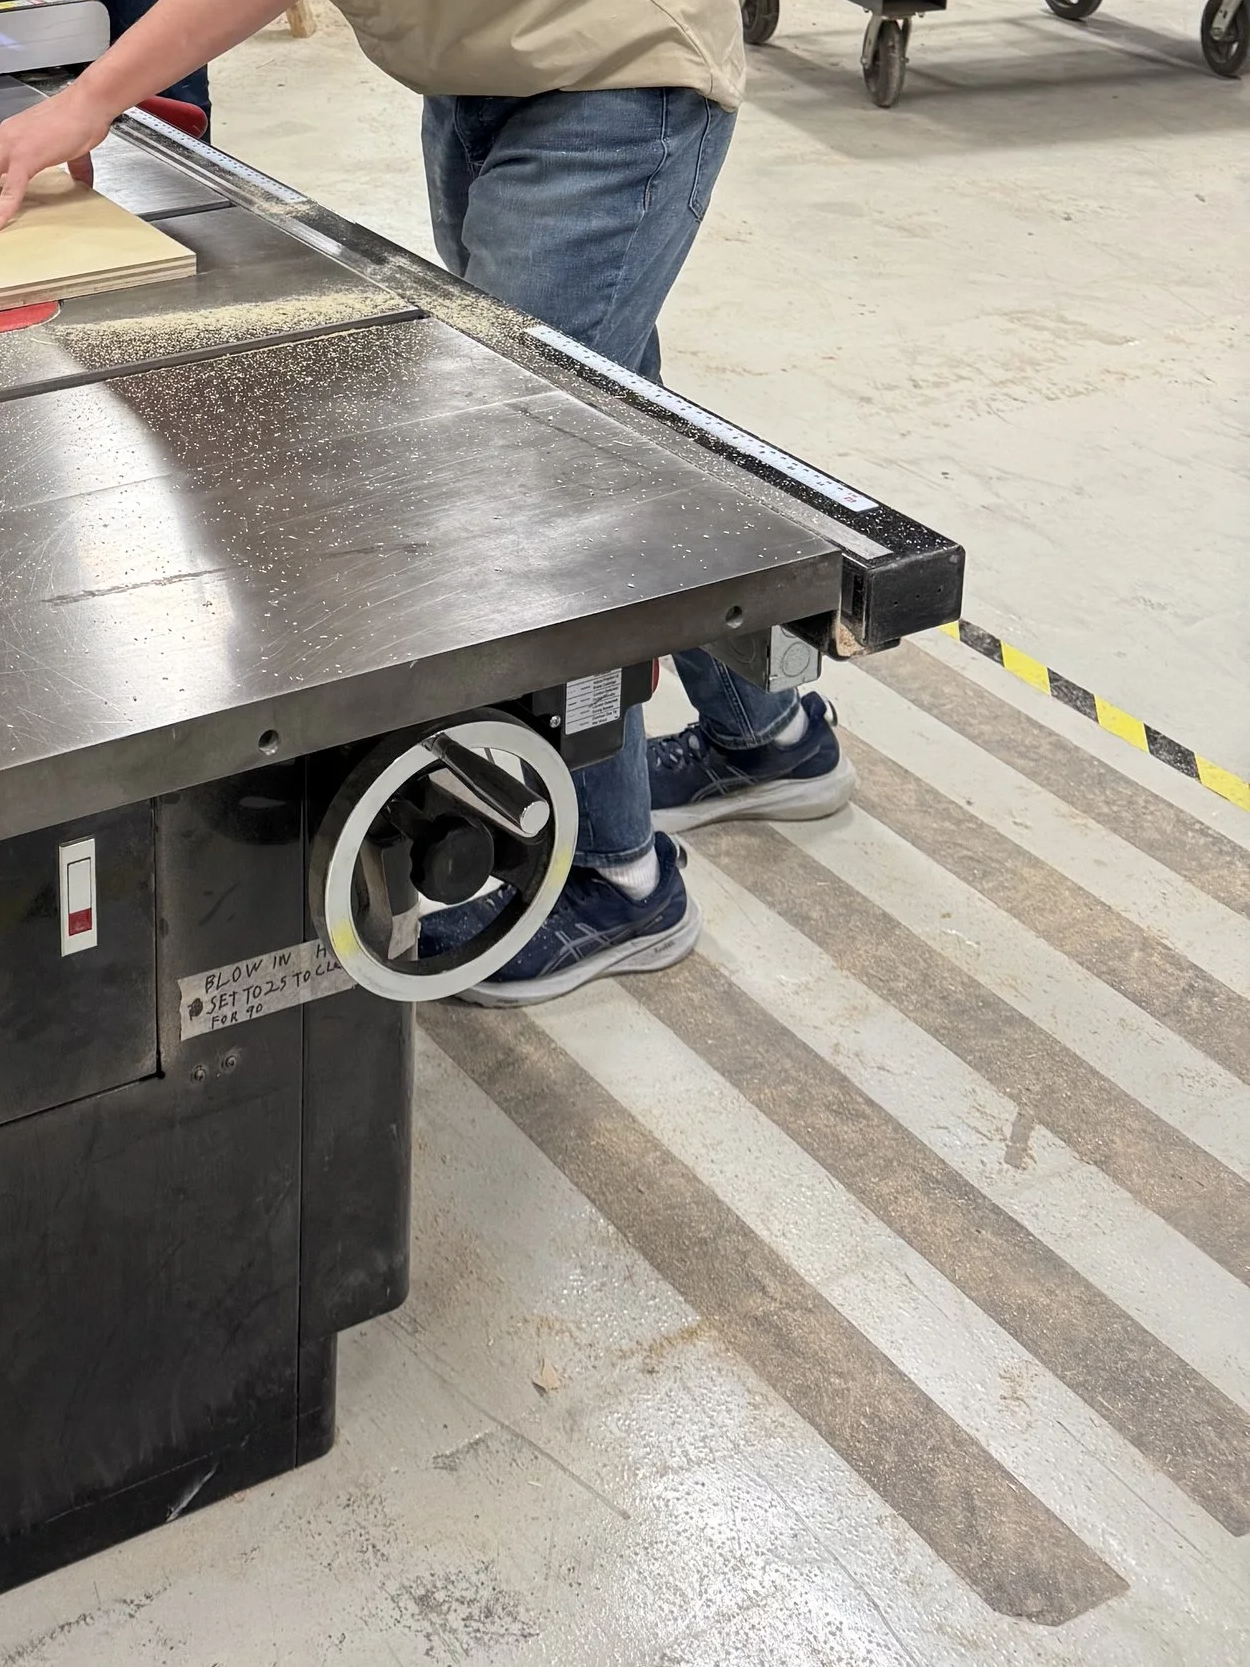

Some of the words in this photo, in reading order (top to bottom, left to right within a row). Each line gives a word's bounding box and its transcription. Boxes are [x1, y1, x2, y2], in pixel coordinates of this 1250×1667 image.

[205, 959, 263, 994] BLOW
[272, 952, 292, 970] IN
[242, 985, 263, 1005] TO
[264, 975, 287, 996] 25
[292, 970, 311, 988] TO
[211, 1010, 238, 1030] FOR
